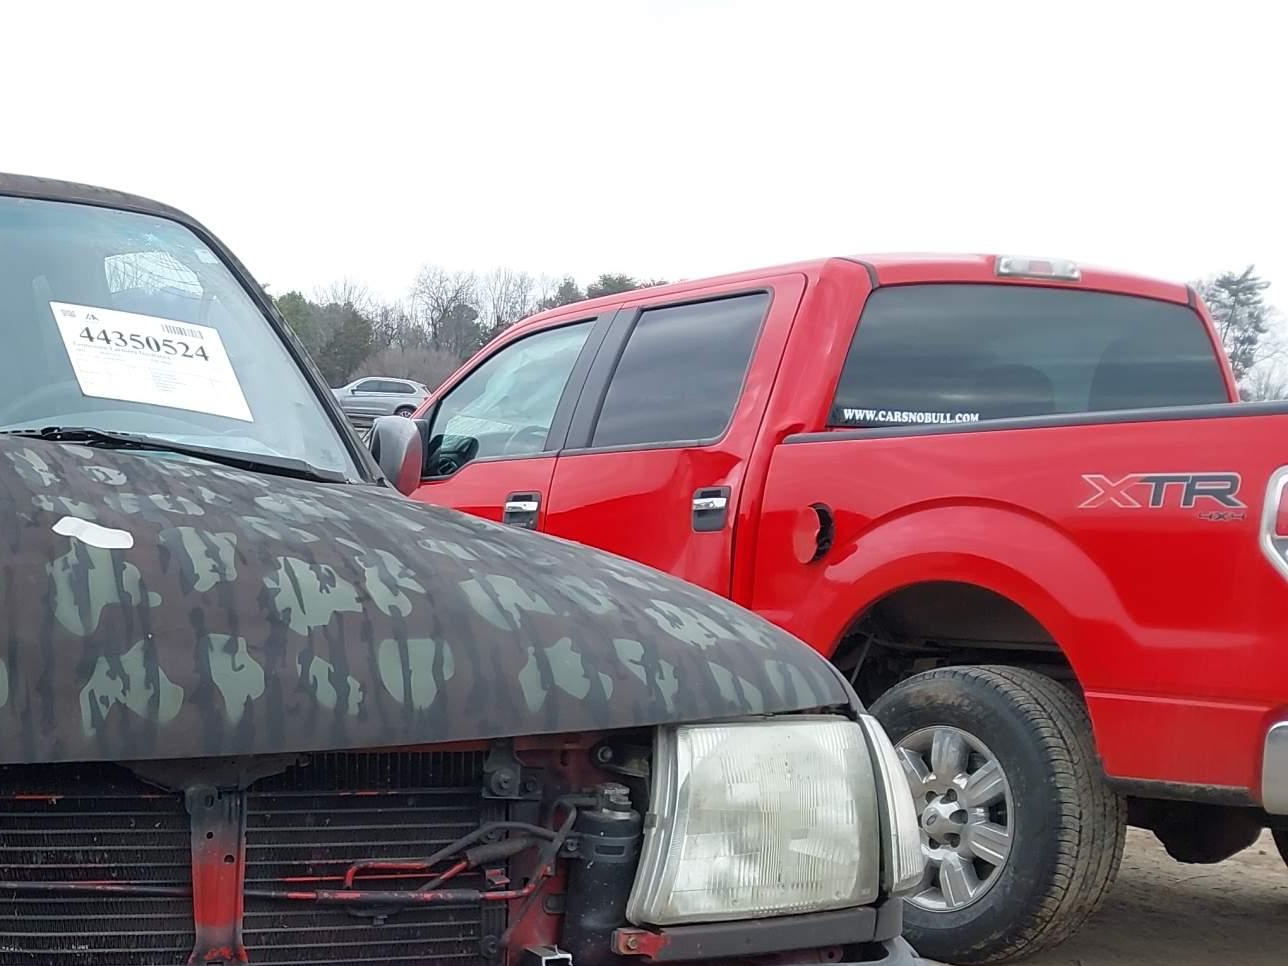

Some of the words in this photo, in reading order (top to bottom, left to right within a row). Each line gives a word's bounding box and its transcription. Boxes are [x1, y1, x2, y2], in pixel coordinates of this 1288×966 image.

[79, 326, 209, 361] 44350524
[843, 408, 979, 424] WWW.CARSNOBULL.COM
[1078, 472, 1248, 508] XTR
